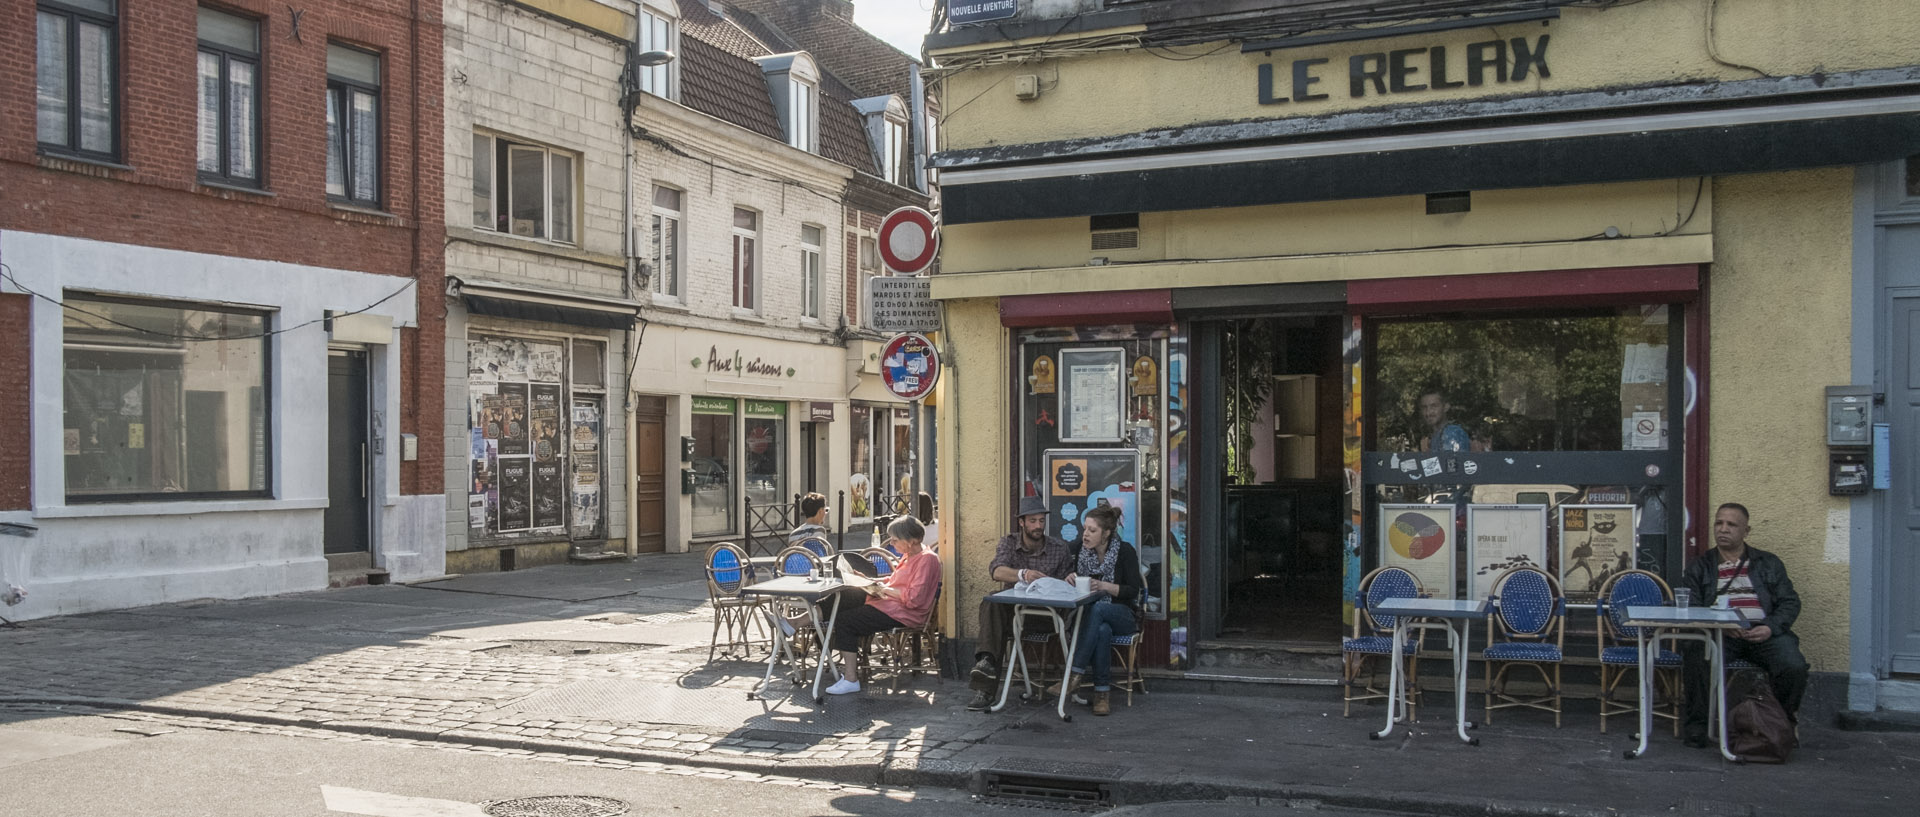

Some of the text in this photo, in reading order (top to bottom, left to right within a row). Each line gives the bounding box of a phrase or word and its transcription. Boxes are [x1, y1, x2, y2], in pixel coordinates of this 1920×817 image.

[951, 0, 1014, 16] NOUVELLE AVENTURE
[1258, 34, 1550, 104] LE RELAX
[708, 344, 782, 378] Aux 4 saisons
[812, 407, 832, 415] Bienvenue
[1588, 493, 1626, 502] PELFORTH
[1565, 520, 1584, 528] NORD
[1477, 534, 1491, 542] OPÉRA
